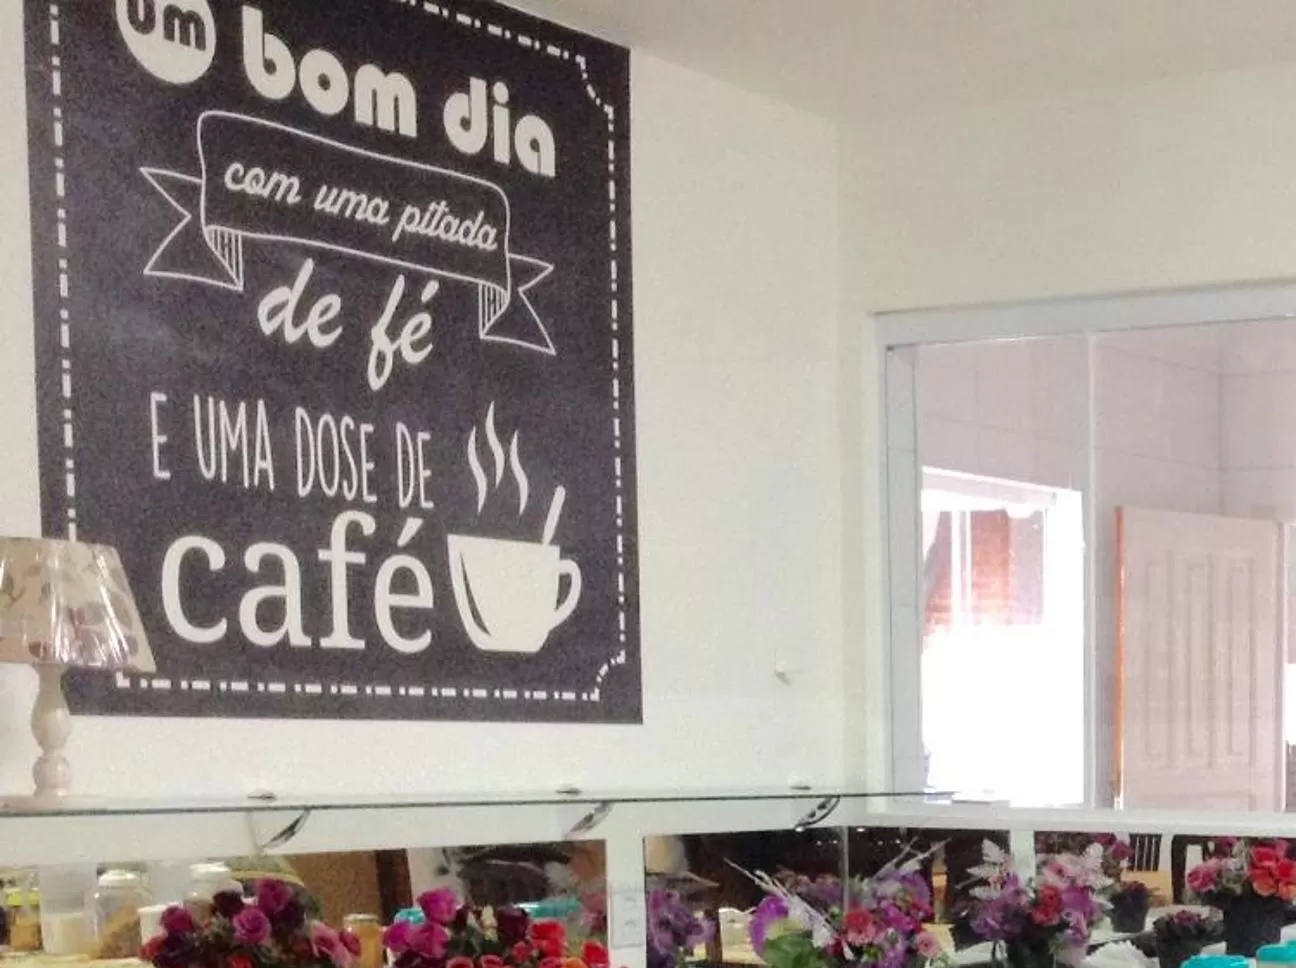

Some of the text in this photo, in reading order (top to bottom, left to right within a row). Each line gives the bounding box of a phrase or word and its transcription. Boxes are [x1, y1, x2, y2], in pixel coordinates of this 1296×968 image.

[242, 6, 417, 138] bom
[443, 78, 556, 178] dia
[224, 162, 498, 252] com uma pitada
[257, 257, 440, 392] de fé
[150, 391, 435, 510] E UMA DOSE DE
[160, 509, 434, 654] café
